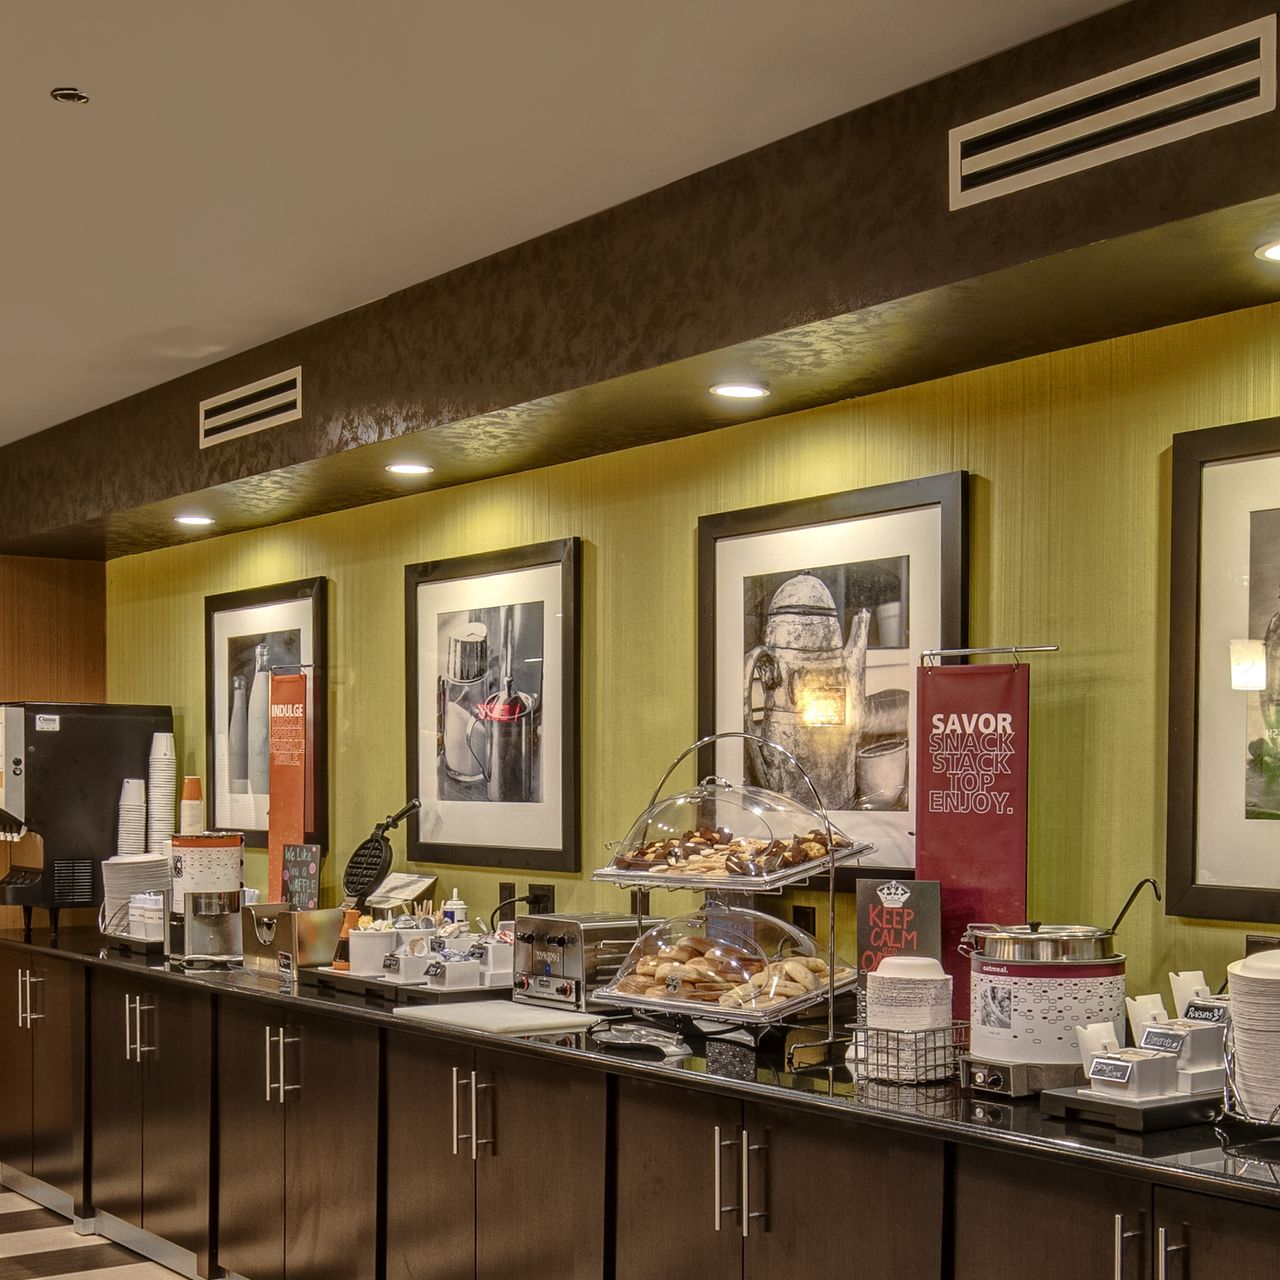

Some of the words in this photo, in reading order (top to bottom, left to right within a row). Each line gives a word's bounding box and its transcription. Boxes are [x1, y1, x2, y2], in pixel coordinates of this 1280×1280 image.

[272, 704, 303, 717] INDULGE
[932, 714, 1013, 734] SAVOR
[929, 732, 1015, 753] SNACK
[932, 752, 1011, 773] STACK
[947, 771, 995, 793] TOP
[928, 790, 1013, 814] ENJOY.
[868, 904, 915, 930] KEEP
[870, 927, 918, 951] CALM
[1187, 1007, 1214, 1020] Raisins
